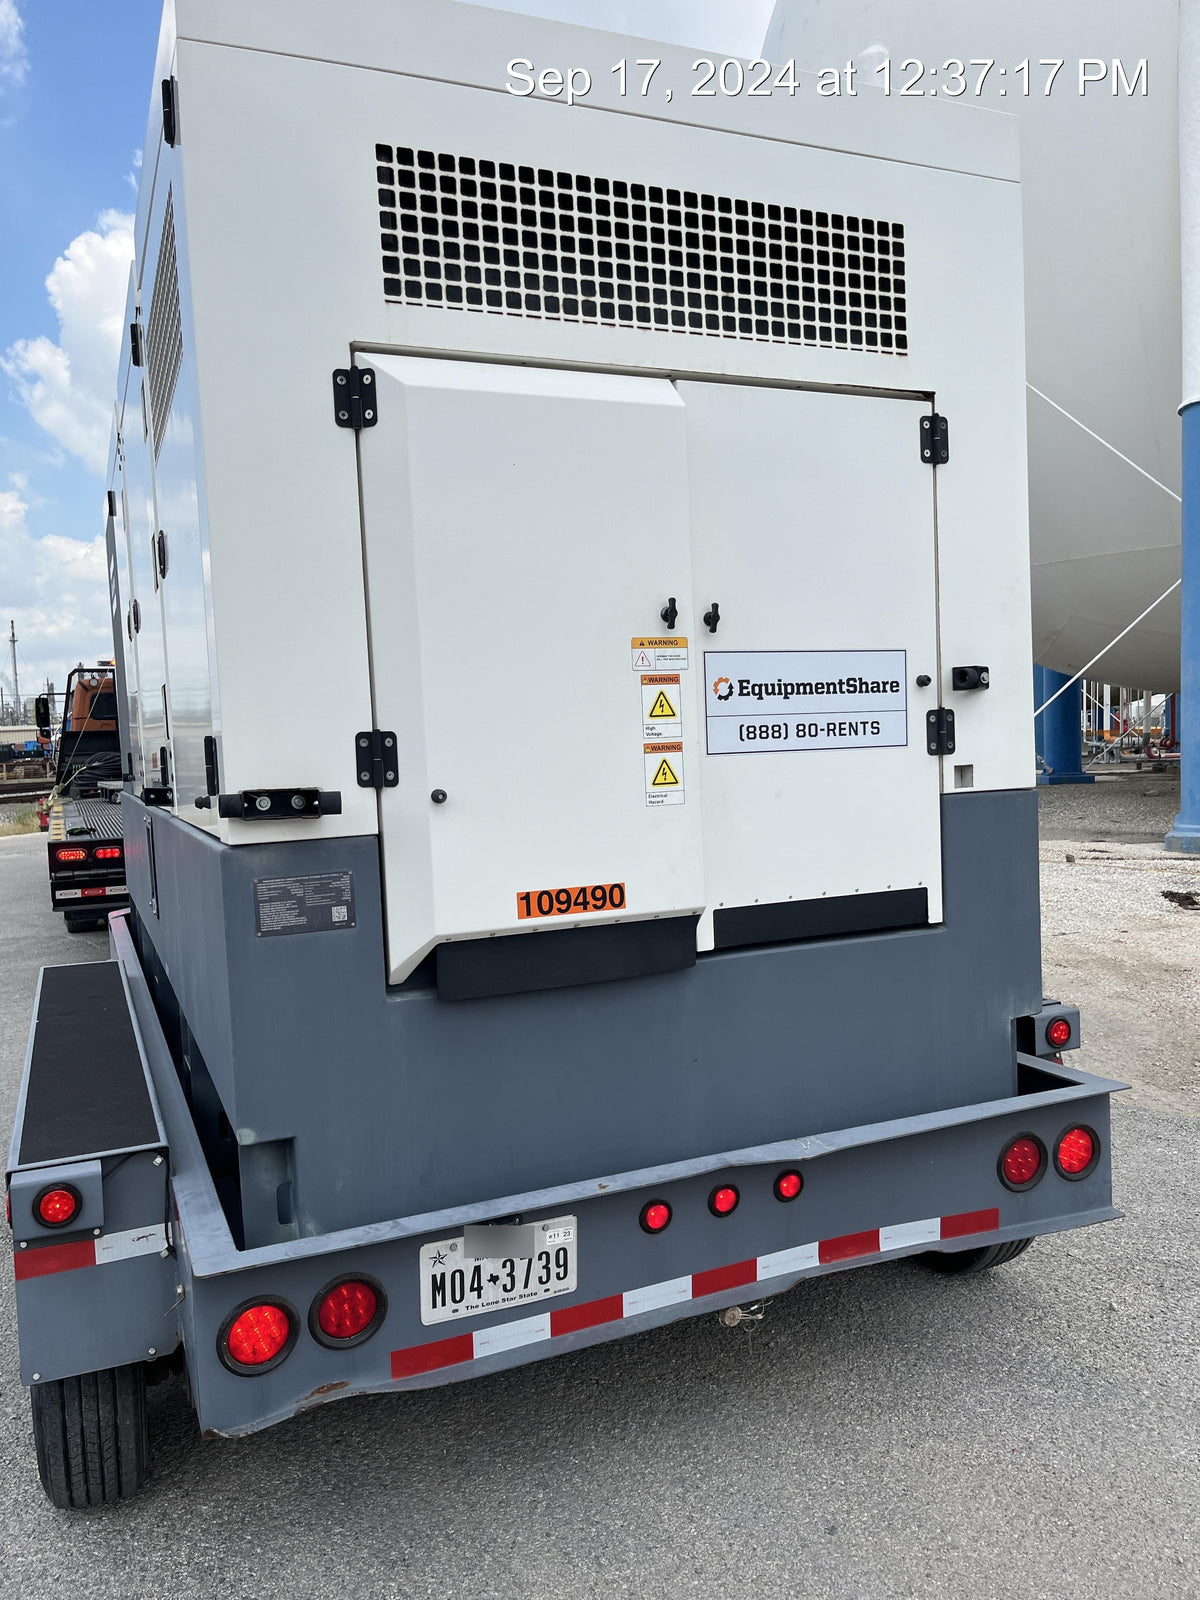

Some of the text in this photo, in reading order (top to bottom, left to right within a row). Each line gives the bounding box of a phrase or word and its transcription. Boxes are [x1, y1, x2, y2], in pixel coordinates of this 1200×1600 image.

[737, 677, 900, 701] EquipmentShare
[739, 721, 881, 742] (888) 80-RENTS
[651, 743, 682, 752] WARNING
[519, 883, 625, 917] 109490
[465, 1291, 538, 1311] The Lone Star State
